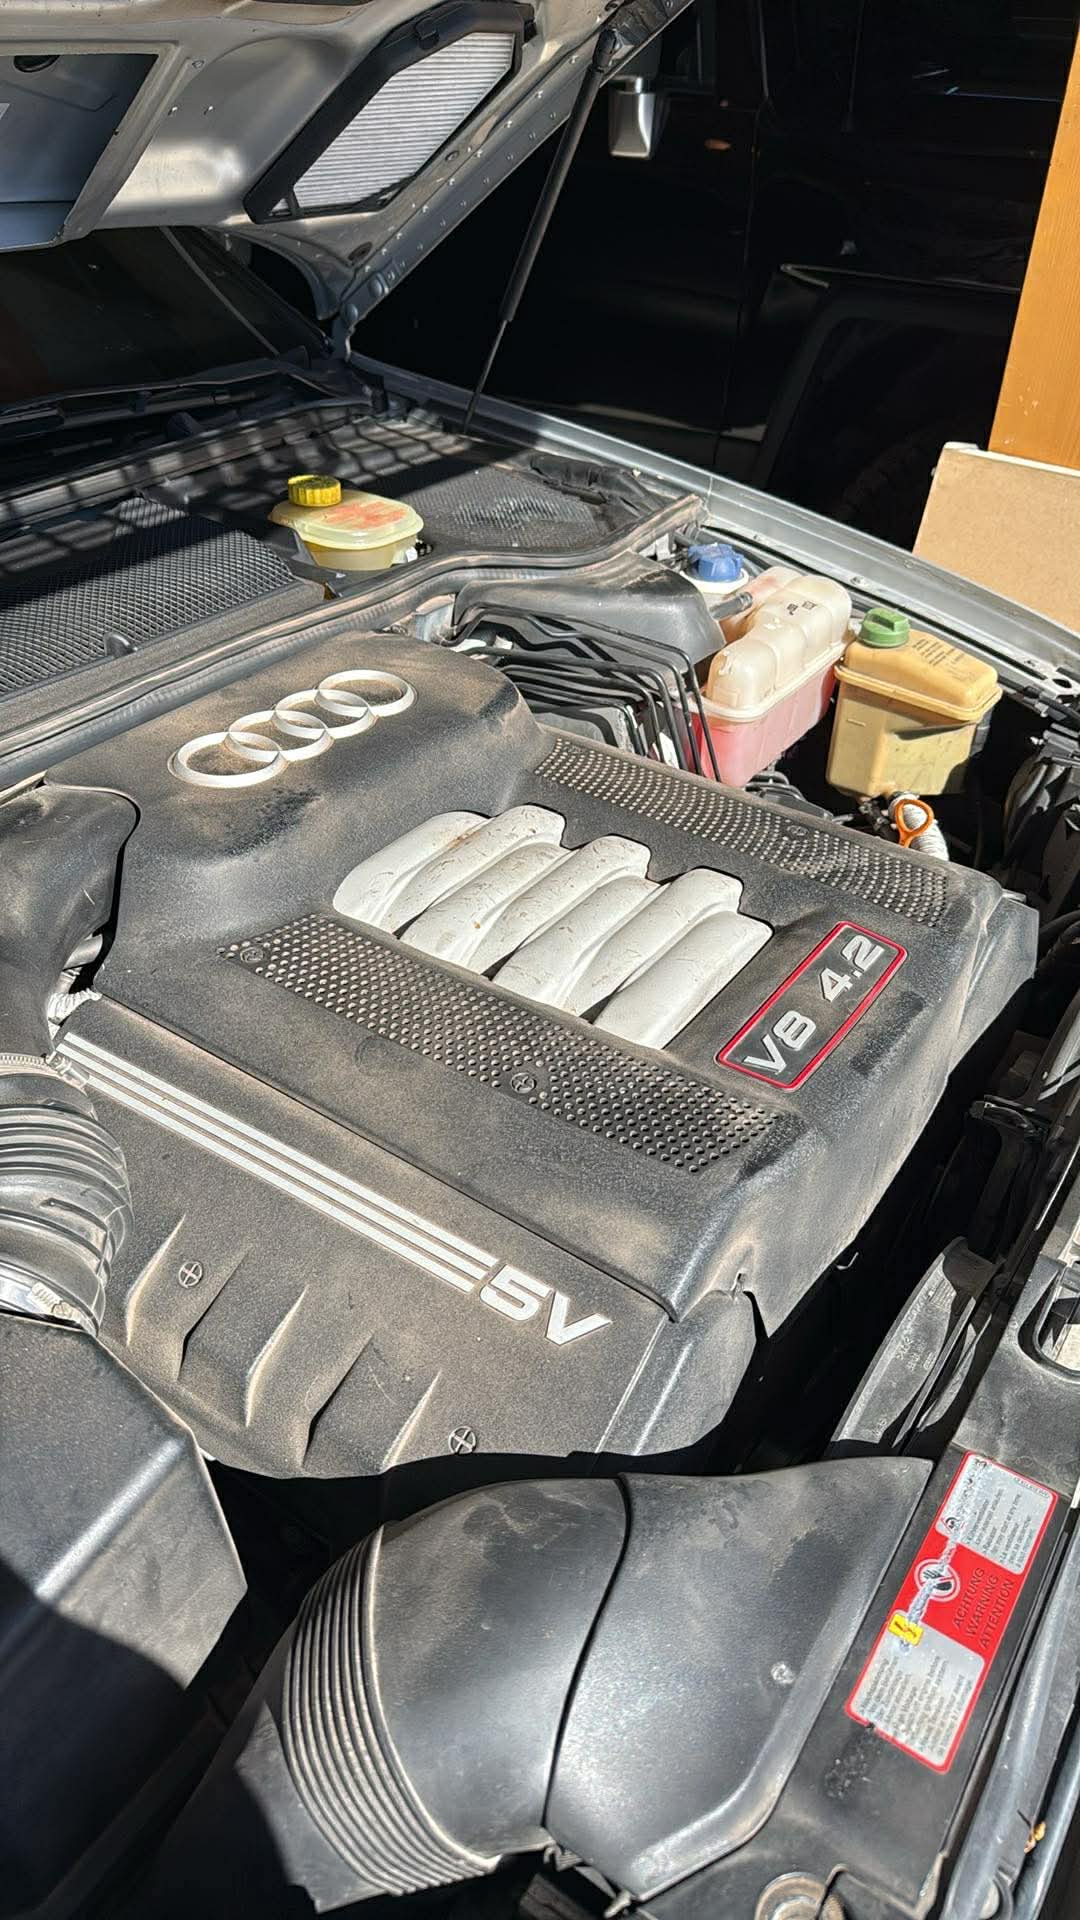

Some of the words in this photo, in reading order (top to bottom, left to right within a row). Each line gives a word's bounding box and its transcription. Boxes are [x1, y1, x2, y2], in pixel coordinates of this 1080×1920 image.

[743, 1010, 816, 1075] V8
[819, 935, 885, 1003] 4.2
[480, 1264, 613, 1347] 5V
[954, 1567, 985, 1627] ACHTUNG
[966, 1574, 999, 1636] WARNING
[980, 1578, 1014, 1648] ATTENTION
